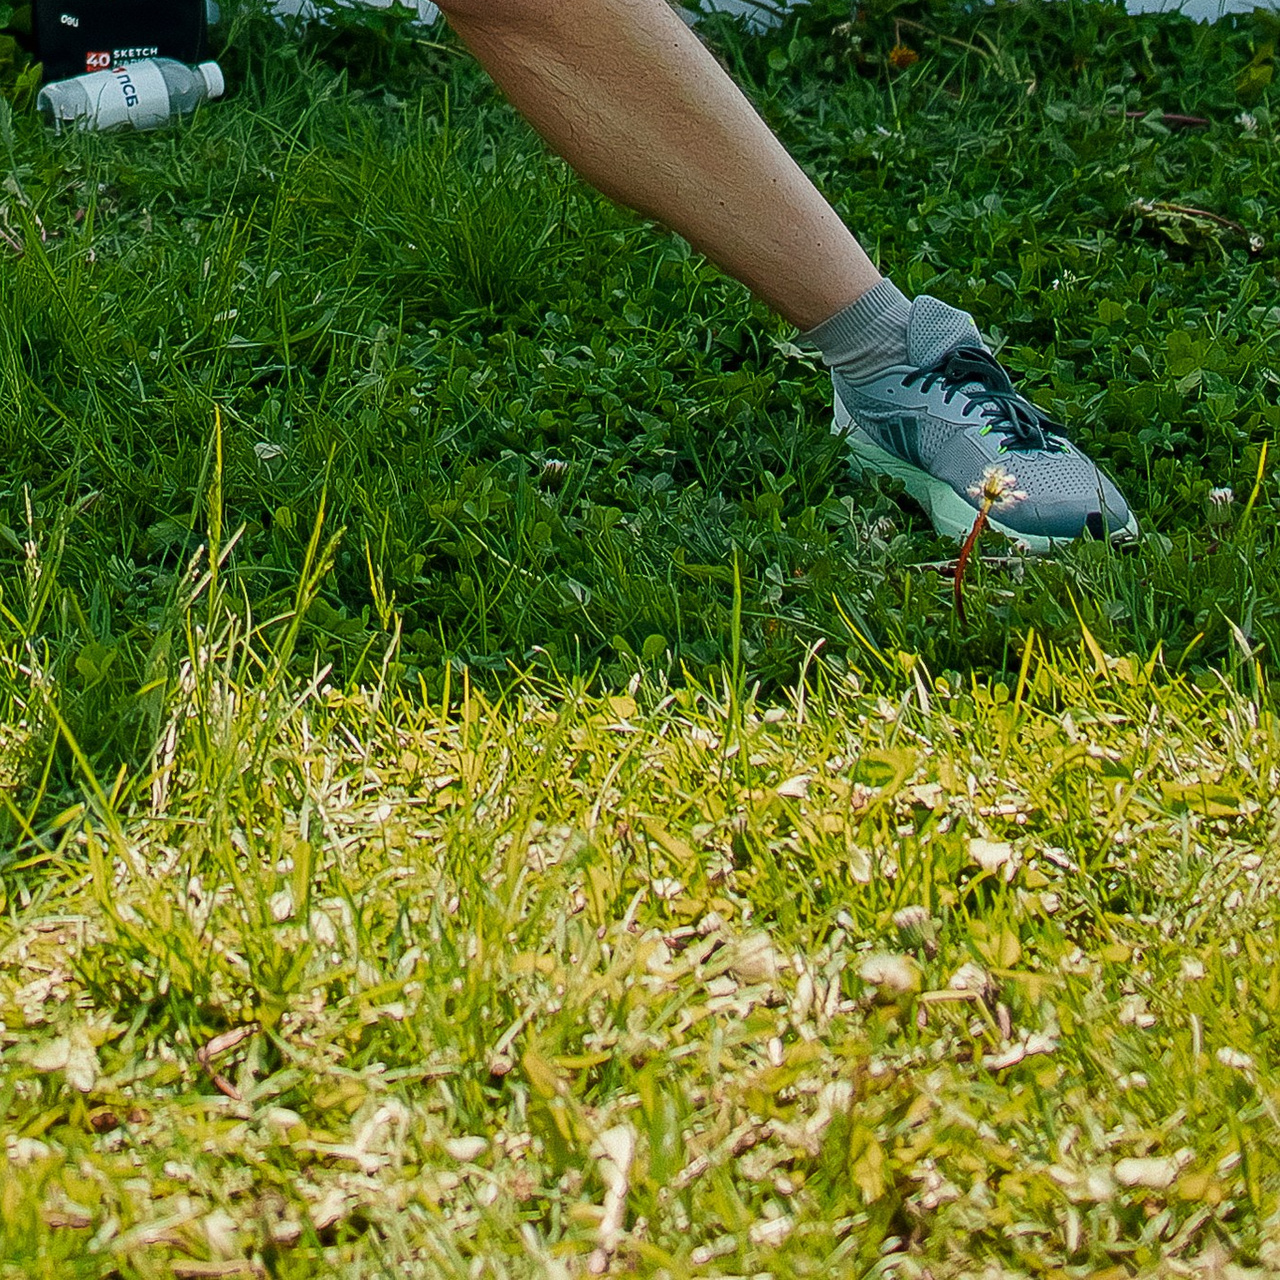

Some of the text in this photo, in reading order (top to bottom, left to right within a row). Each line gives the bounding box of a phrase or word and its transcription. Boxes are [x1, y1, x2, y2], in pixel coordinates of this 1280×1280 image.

[86, 48, 158, 66] 40 SKETCH
[116, 74, 139, 108] ПСБ
